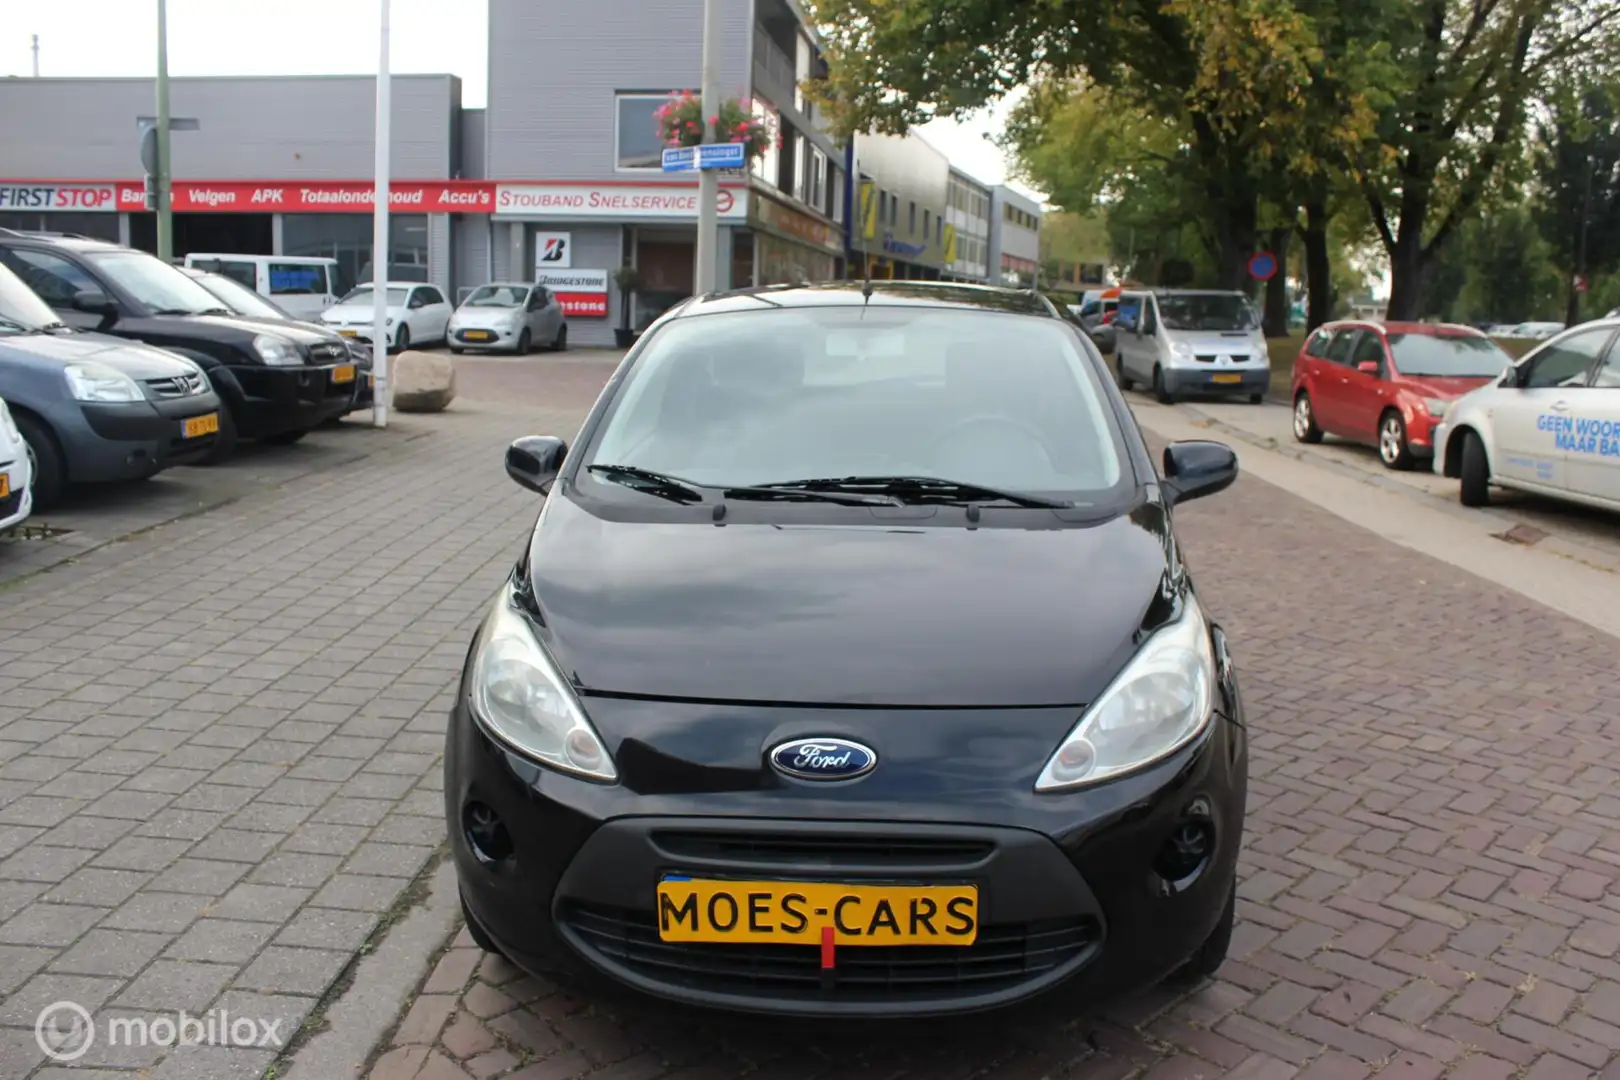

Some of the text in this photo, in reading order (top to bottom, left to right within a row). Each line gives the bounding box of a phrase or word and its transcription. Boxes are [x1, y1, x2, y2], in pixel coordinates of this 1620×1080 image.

[189, 189, 236, 206] Velgen
[251, 189, 283, 203] APK
[438, 189, 490, 204] Accu's
[499, 190, 697, 210] STOUBAND SNELSERVICE
[1537, 415, 1573, 432] GEEN
[1555, 432, 1596, 453] MAAR
[794, 744, 852, 769] Ford
[659, 890, 976, 937] MOES-CARS
